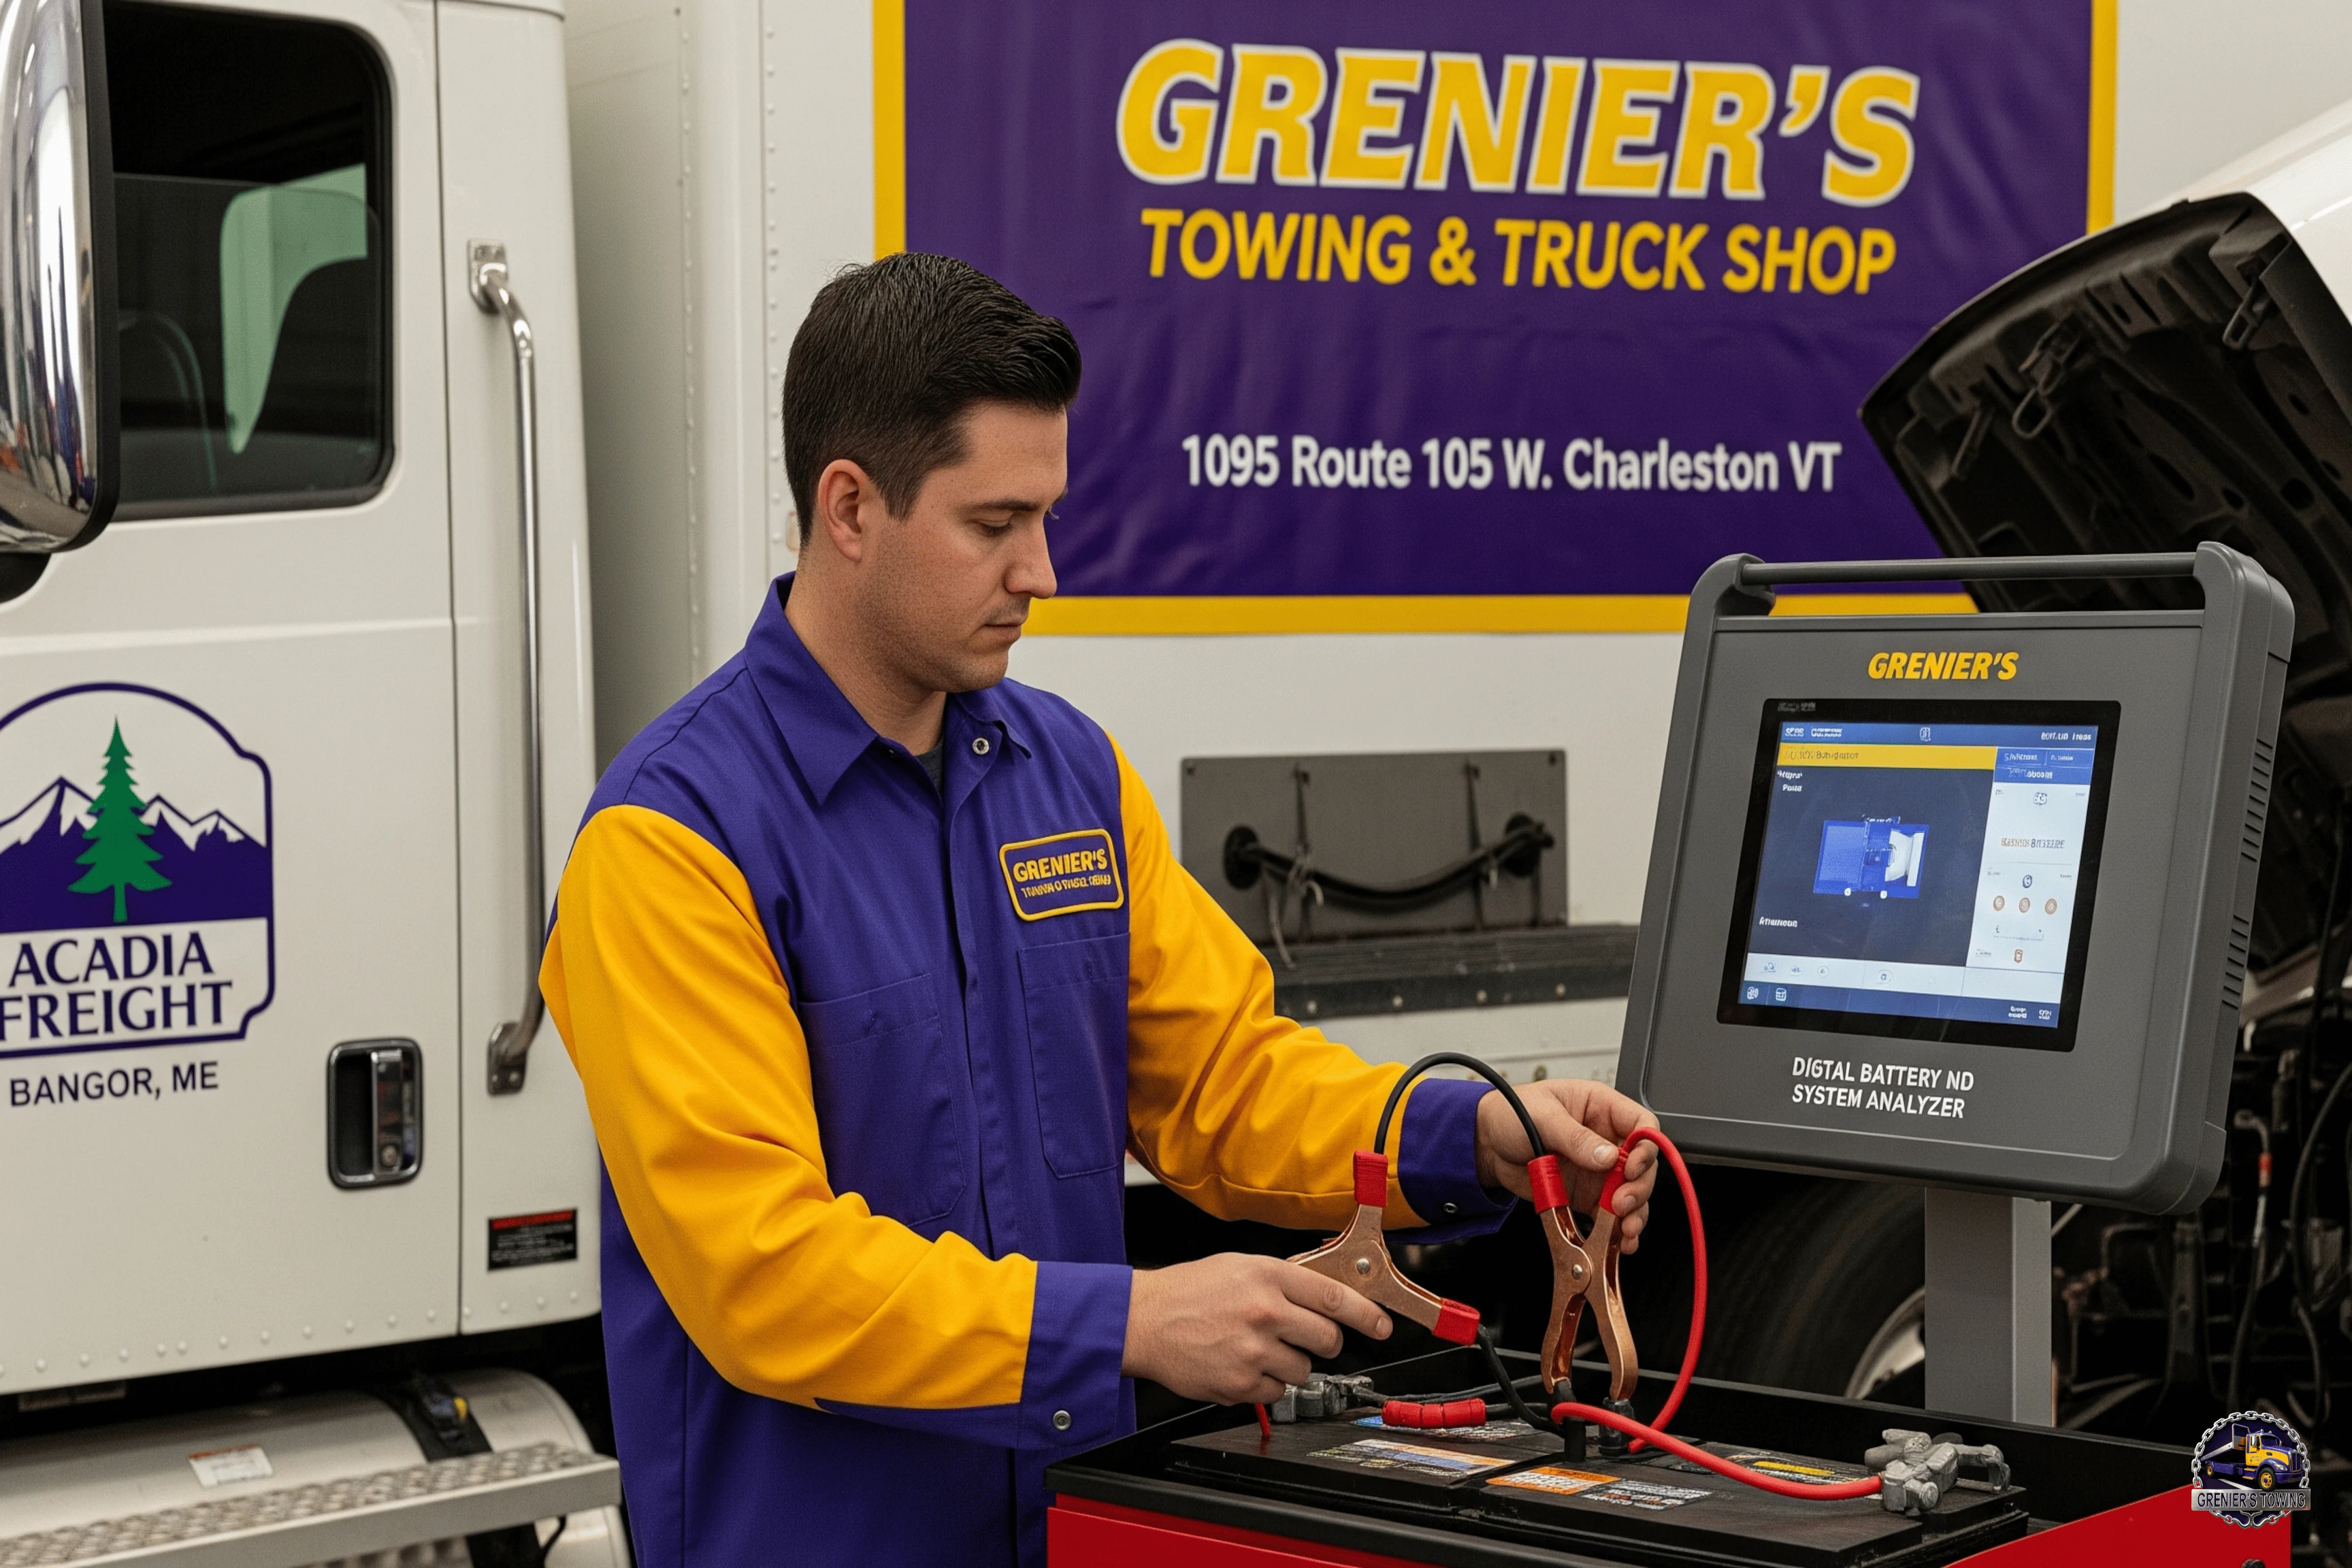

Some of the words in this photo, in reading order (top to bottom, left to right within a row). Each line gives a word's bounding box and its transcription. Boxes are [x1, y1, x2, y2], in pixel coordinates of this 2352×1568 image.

[1115, 38, 1921, 208] GRENIER'S
[1141, 209, 1411, 284] TOWING
[1429, 216, 1476, 286] &
[1494, 219, 1708, 292] TRUCK
[1722, 225, 1897, 294] SHOP
[1182, 435, 1279, 488] 1095
[1292, 436, 1411, 488] Route
[1422, 438, 1493, 489] 105
[1502, 439, 1552, 489] W.
[1563, 440, 1778, 491] Charleston
[1788, 443, 1842, 491] VT
[1867, 651, 2020, 681] GRENIER'S
[1013, 849, 1108, 883] GRENIER'S
[9, 932, 214, 987] ACADIA
[0, 981, 233, 1041] FREIGHT
[10, 1067, 161, 1107] BANGOR,
[172, 1061, 218, 1092] ME
[1792, 1057, 1855, 1082] DIGTAL
[1860, 1063, 1942, 1088] BATTERY
[1946, 1070, 1974, 1091] ND
[1792, 1083, 1863, 1108] SYSTEM
[1865, 1090, 1965, 1118] ANALYZER
